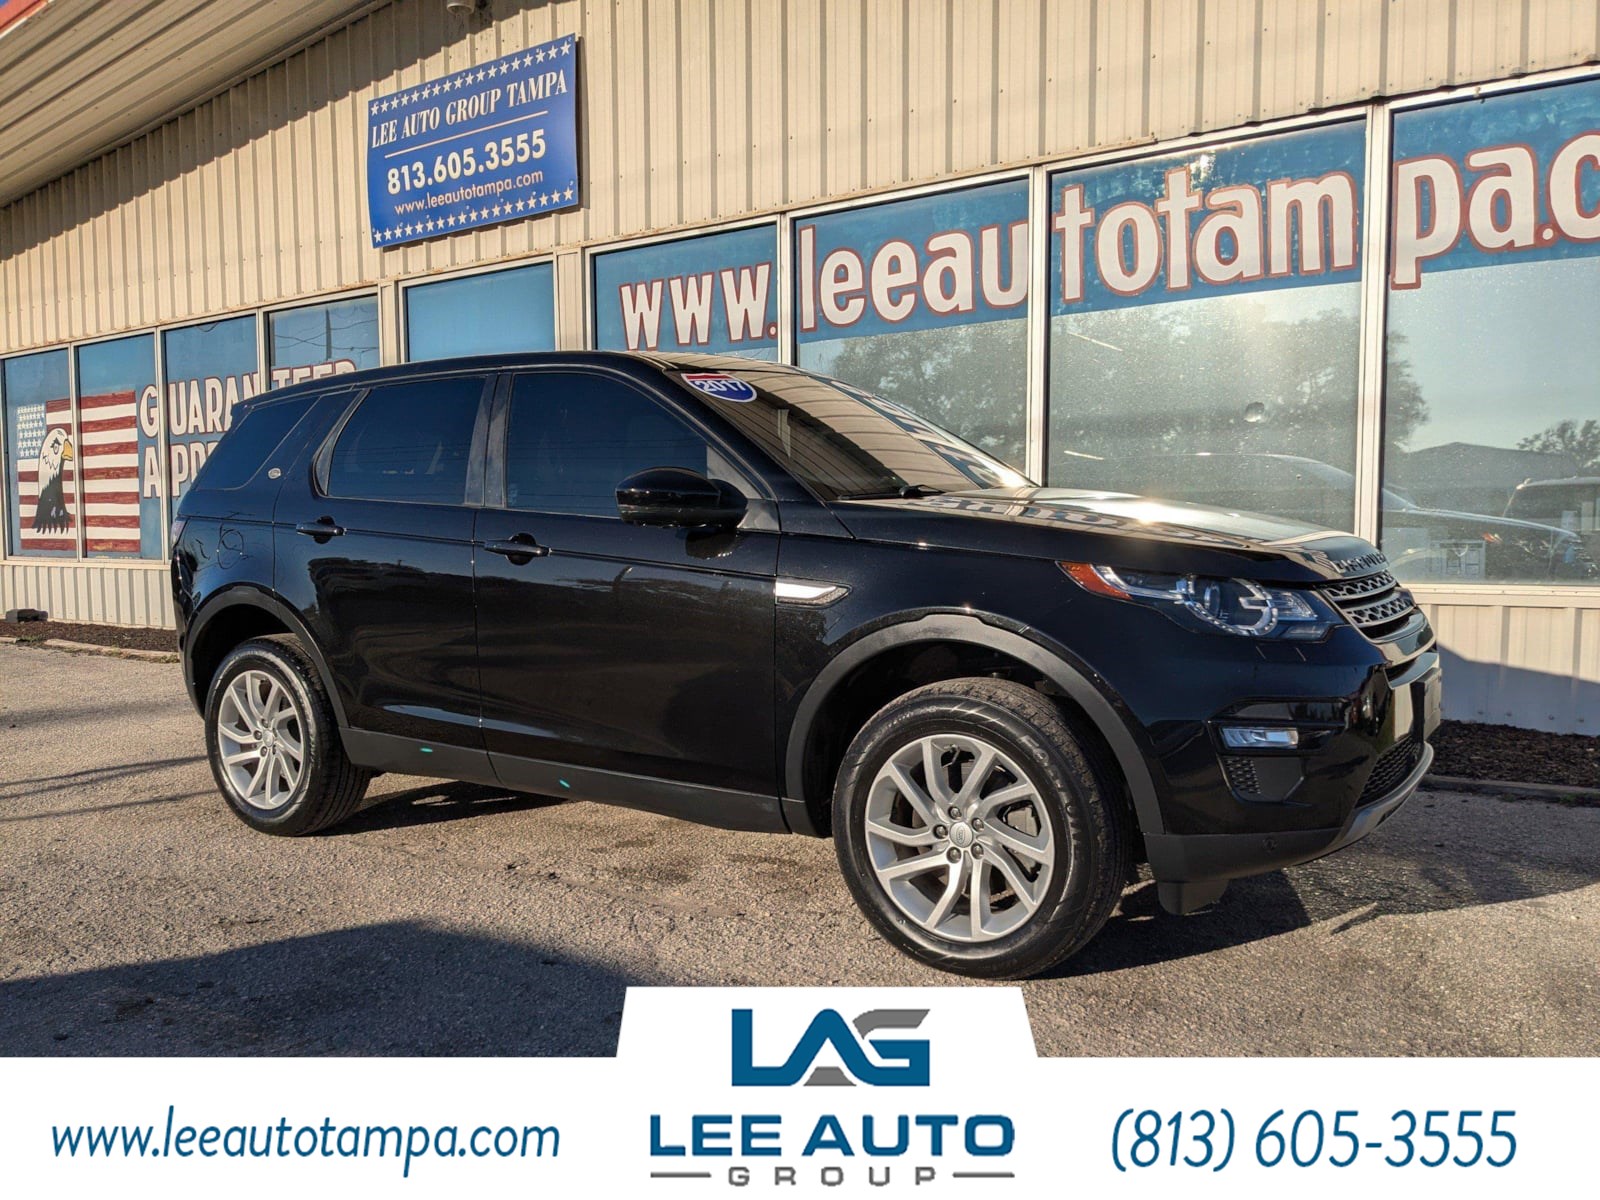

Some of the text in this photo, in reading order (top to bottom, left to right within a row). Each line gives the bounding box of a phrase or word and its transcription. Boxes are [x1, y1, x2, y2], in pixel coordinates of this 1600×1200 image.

[372, 69, 568, 148] LEE AUTO GROUP TAMPA
[387, 128, 546, 195] 813.605.3555
[394, 171, 544, 215] www.leeautotampa.com
[694, 380, 747, 392] 2017
